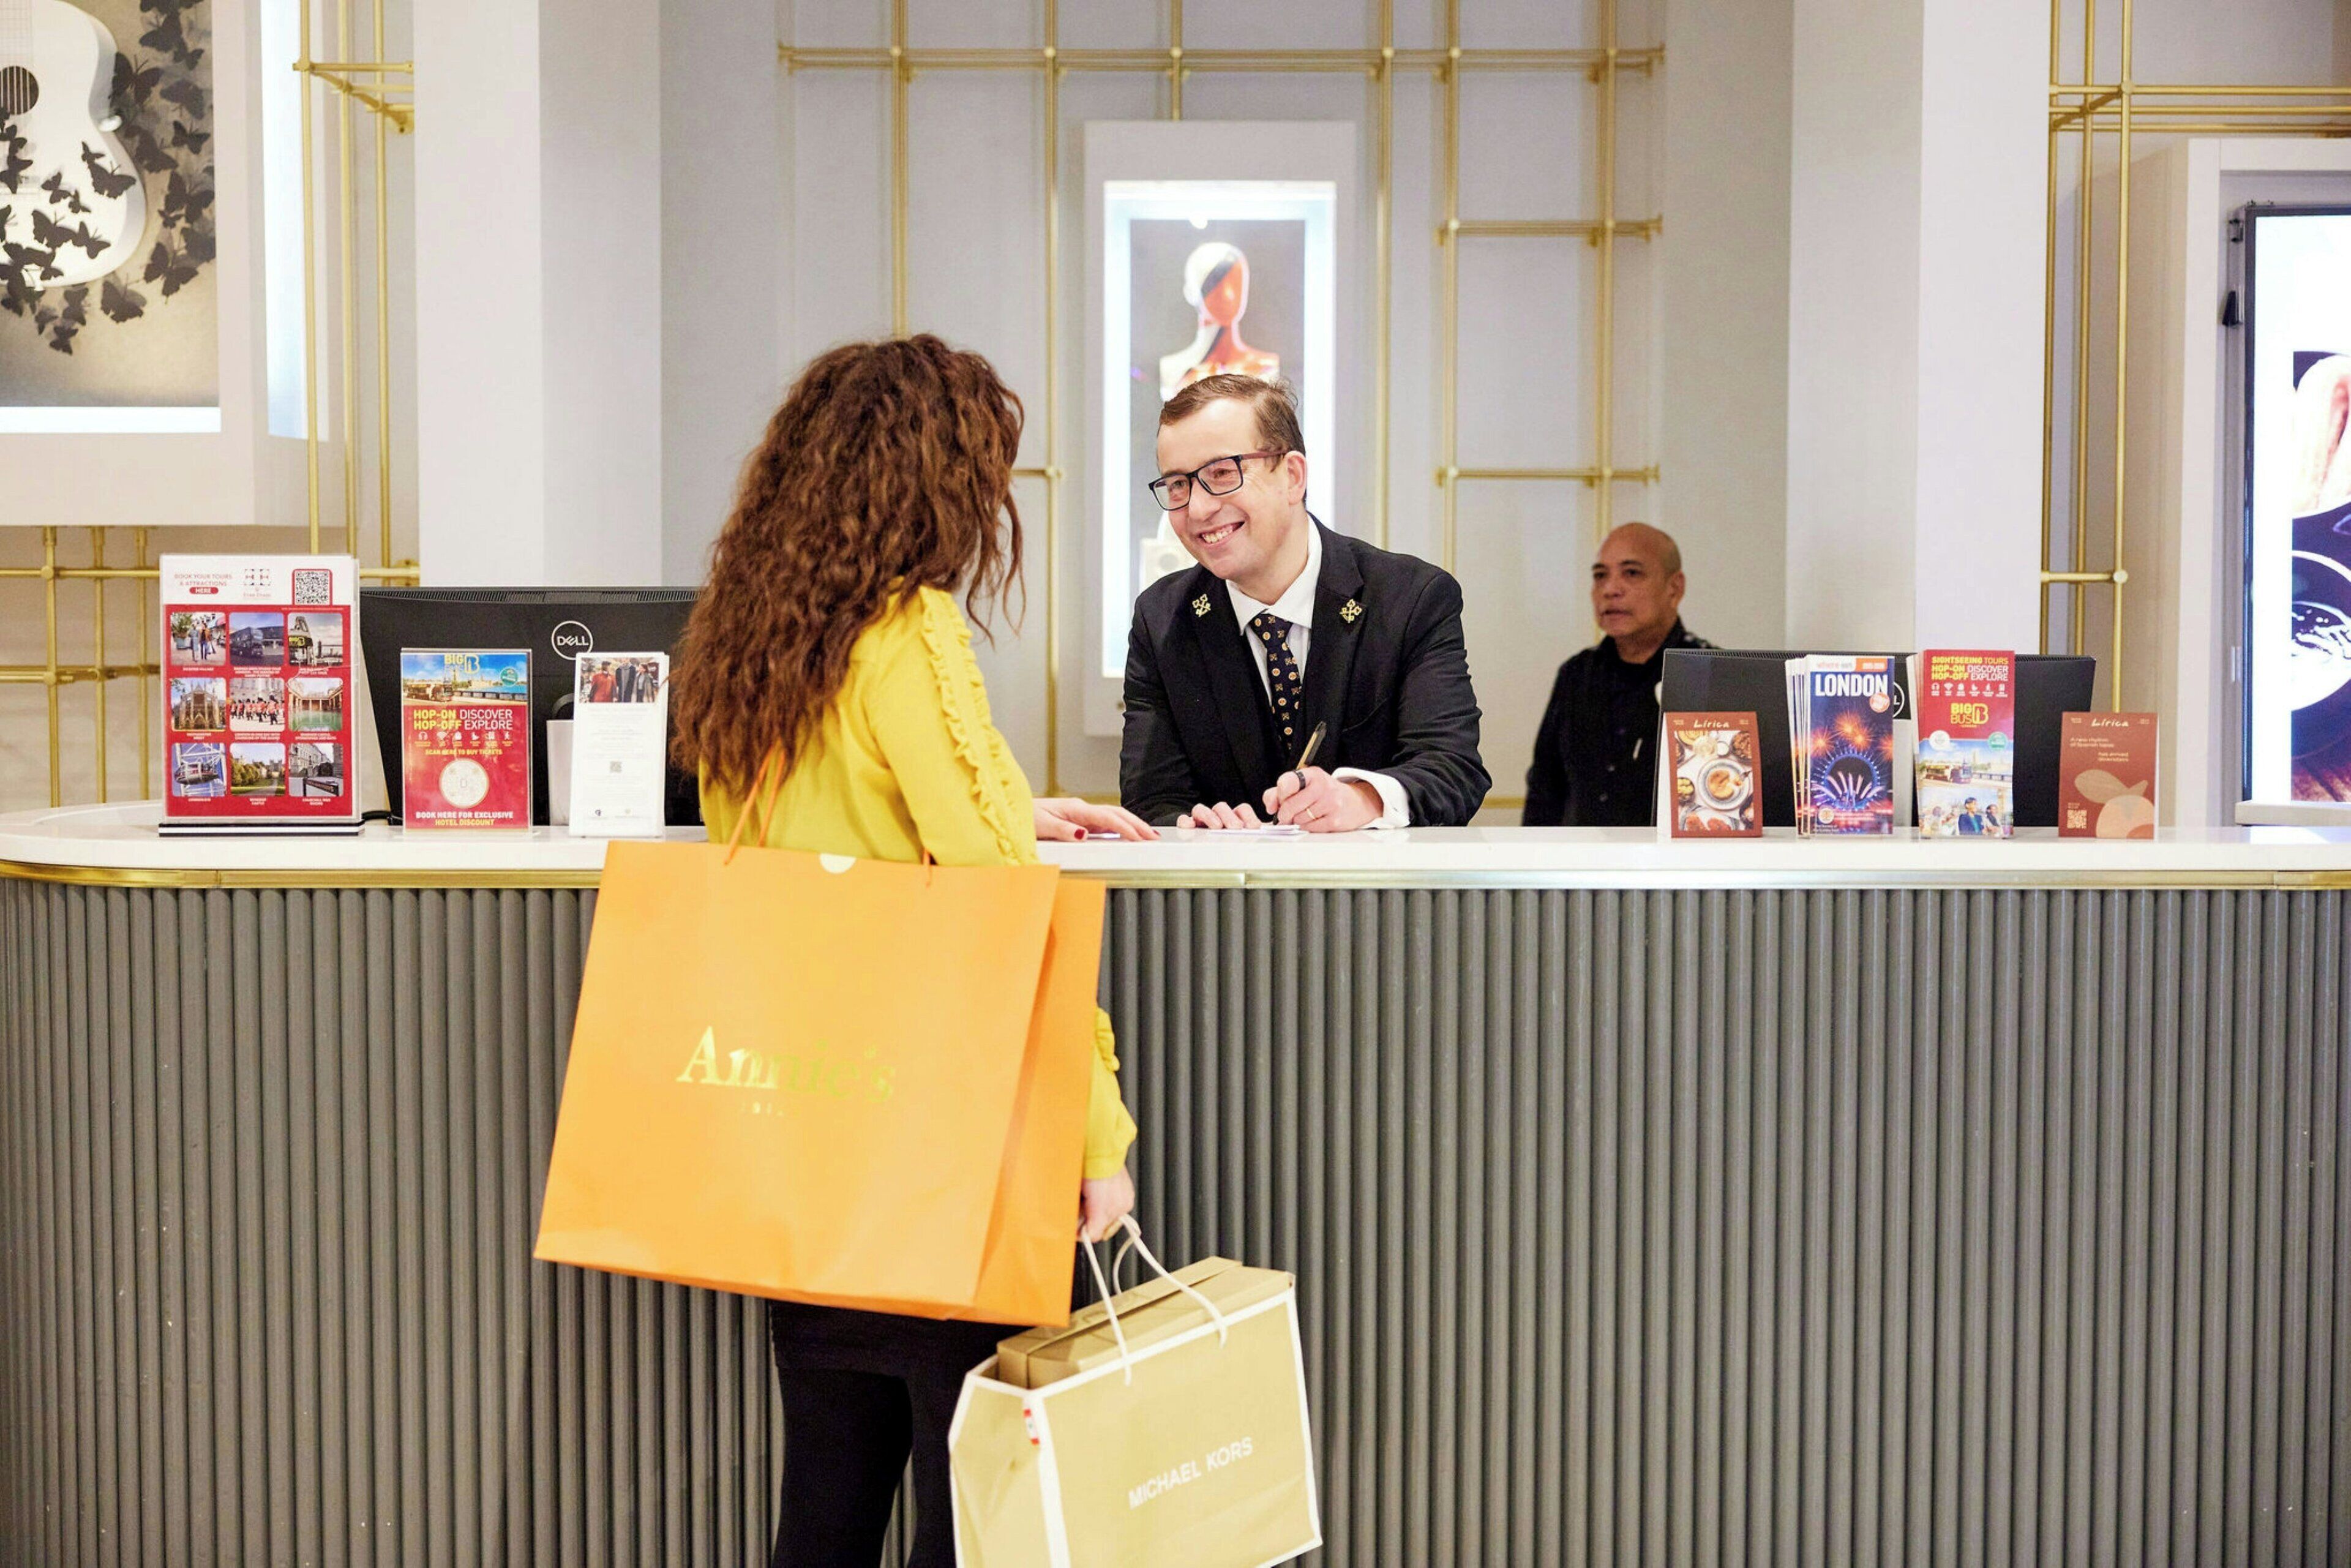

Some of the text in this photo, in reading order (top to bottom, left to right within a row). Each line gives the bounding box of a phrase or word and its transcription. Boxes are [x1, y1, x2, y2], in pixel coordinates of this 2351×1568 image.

[557, 635, 589, 646] DELL
[444, 654, 464, 665] BIG
[1815, 674, 1888, 697] LONDON
[413, 710, 513, 719] HOP-ON DISCOVER
[1951, 703, 1971, 715] BIG
[1951, 714, 1971, 724] BUS
[413, 720, 513, 730] HOP-OFF EXPLORE
[675, 1025, 896, 1103] Annie's
[1128, 1436, 1253, 1510] MICHAEL KORS
